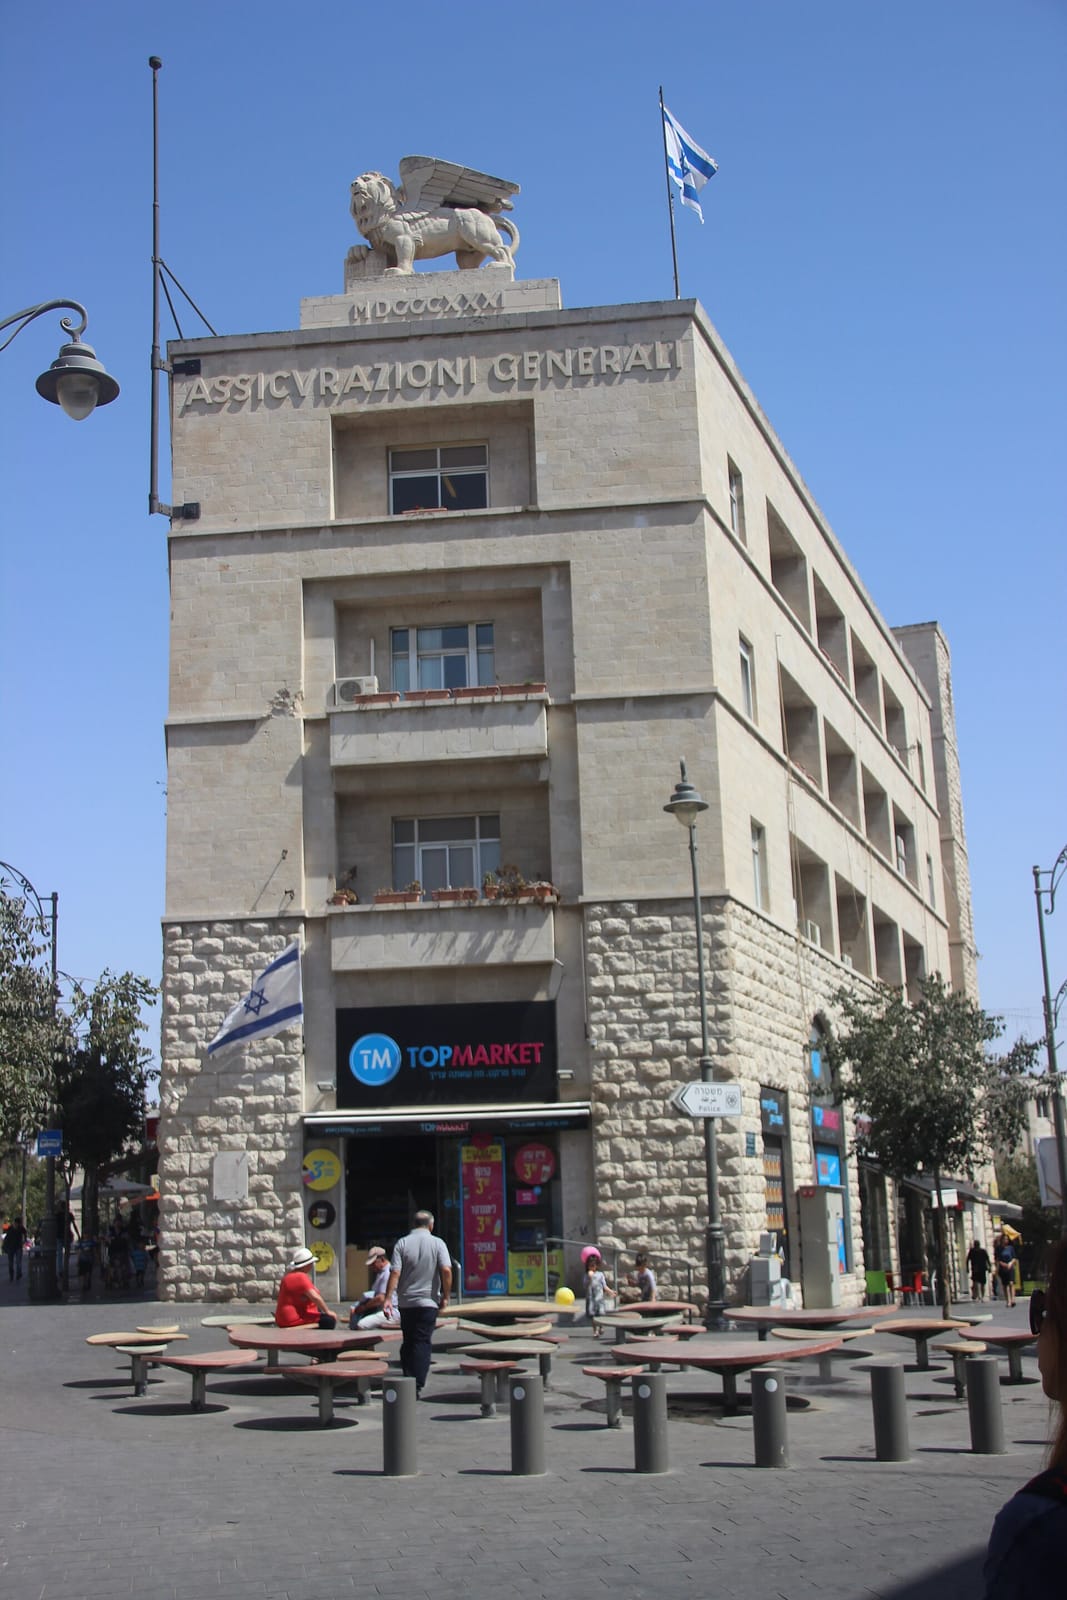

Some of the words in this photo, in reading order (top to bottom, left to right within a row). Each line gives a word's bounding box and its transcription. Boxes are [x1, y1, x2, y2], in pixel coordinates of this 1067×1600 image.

[353, 290, 502, 320] MDCCCXXXI
[186, 356, 477, 406] ASSICVRAZIONI
[493, 340, 682, 382] GENERALI
[359, 1048, 392, 1070] TM
[406, 1042, 544, 1068] TOPMARKET
[694, 1087, 723, 1095] משטרה
